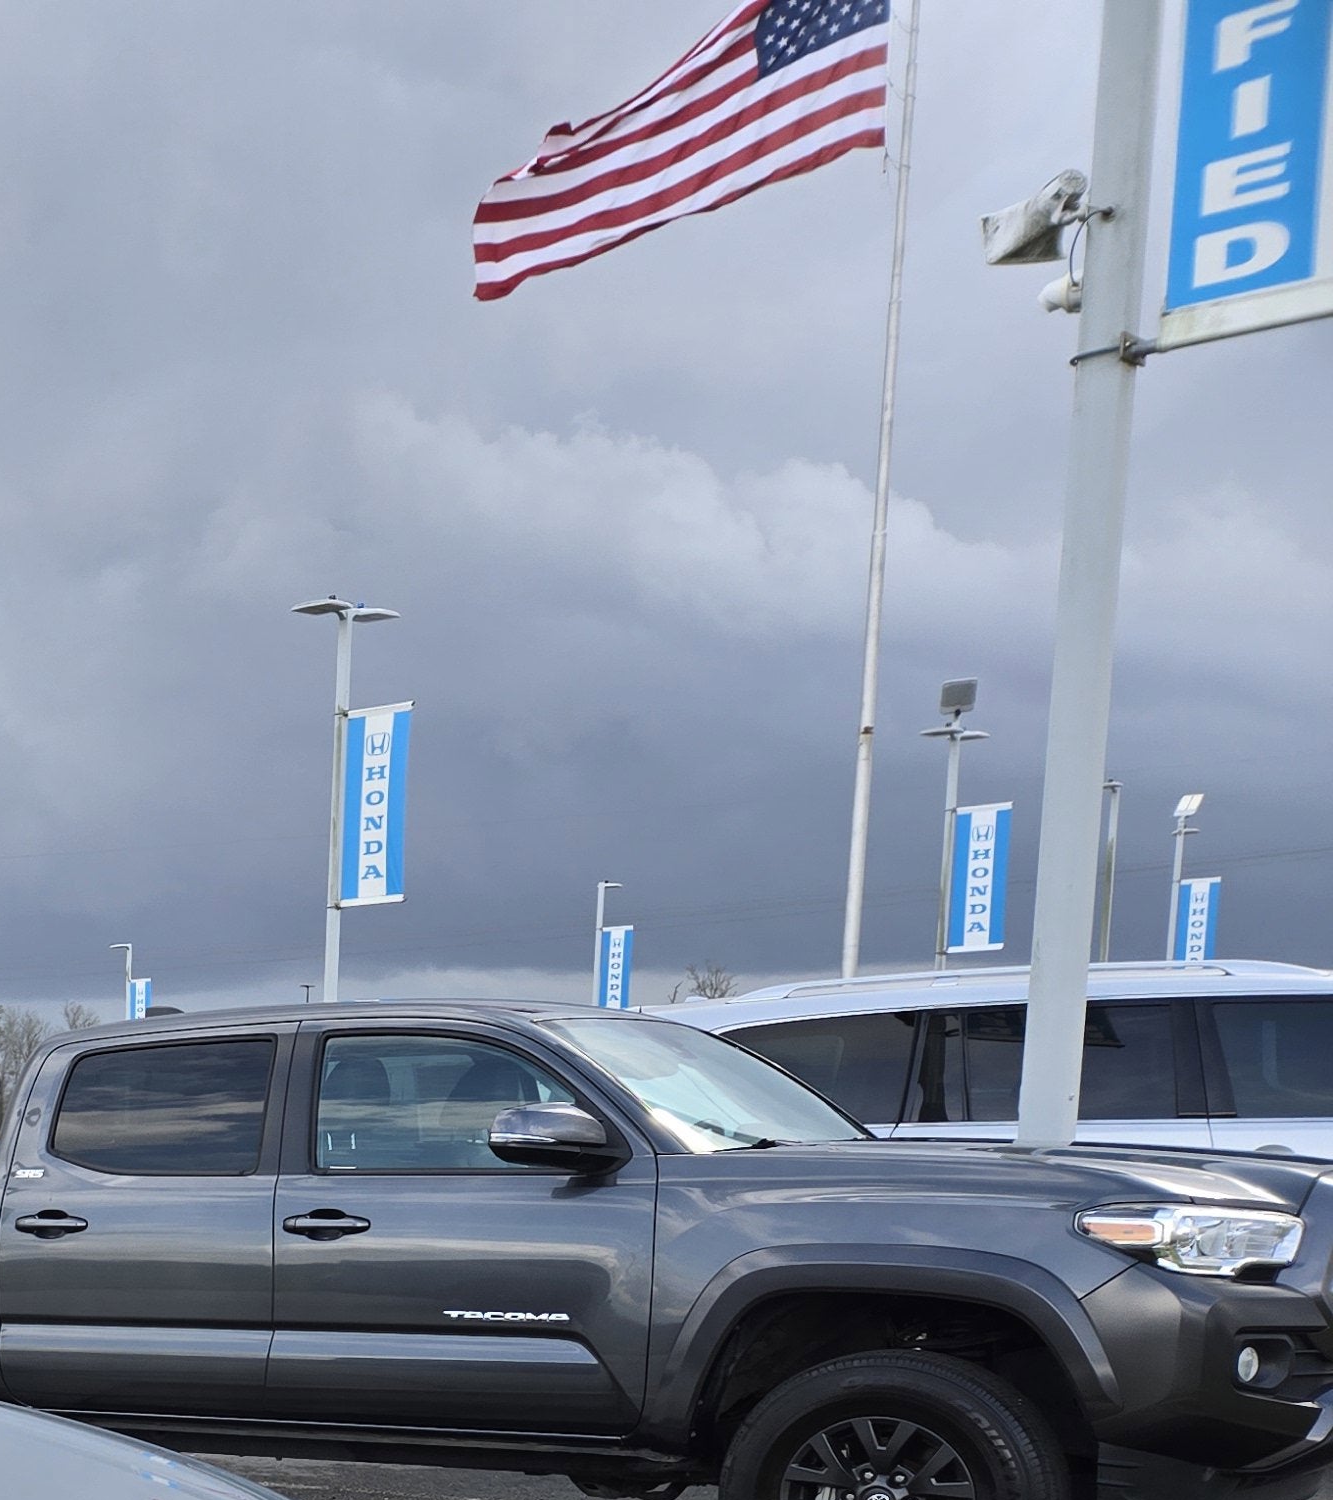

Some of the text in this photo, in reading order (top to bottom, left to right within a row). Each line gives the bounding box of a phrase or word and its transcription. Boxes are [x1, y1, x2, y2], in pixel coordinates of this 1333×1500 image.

[361, 764, 387, 880] HONDA
[966, 848, 991, 933] HONDA
[608, 951, 622, 1001] HONDA
[442, 1310, 571, 1322] TACOMA
